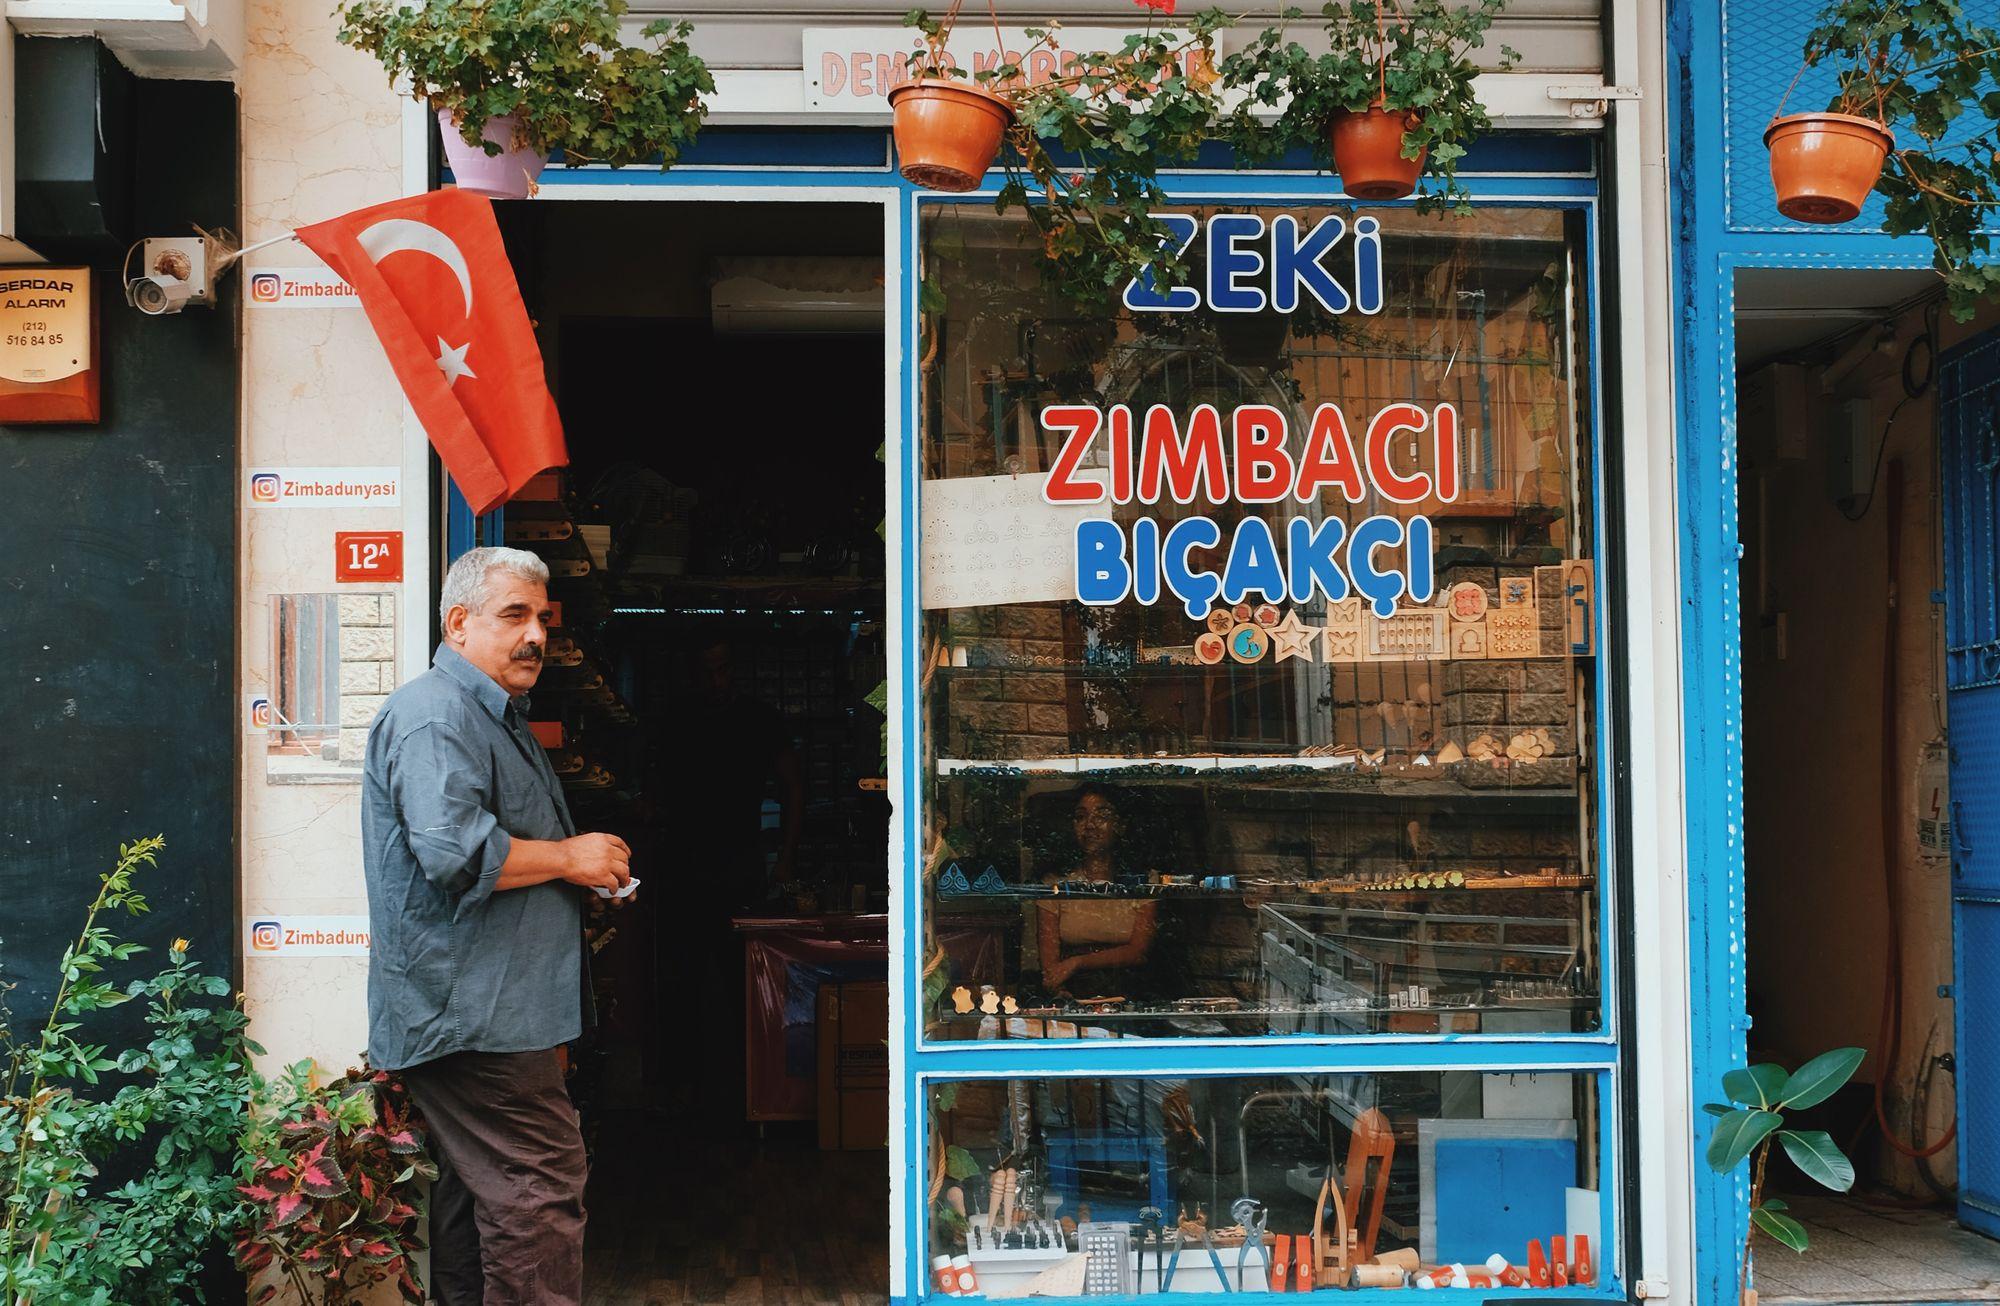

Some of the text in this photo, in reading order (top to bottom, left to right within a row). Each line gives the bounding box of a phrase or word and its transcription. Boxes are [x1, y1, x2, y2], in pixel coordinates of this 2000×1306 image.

[0, 279, 74, 293] SERDAR
[283, 281, 358, 297] Zimbadu
[4, 298, 66, 309] ALARM
[22, 321, 47, 333] (212)
[6, 333, 64, 346] 516 84 85
[1040, 402, 1459, 505] ZIMBACI
[283, 480, 397, 500] Zimbadunyasi
[1074, 515, 1434, 621] BIÇAKÇI
